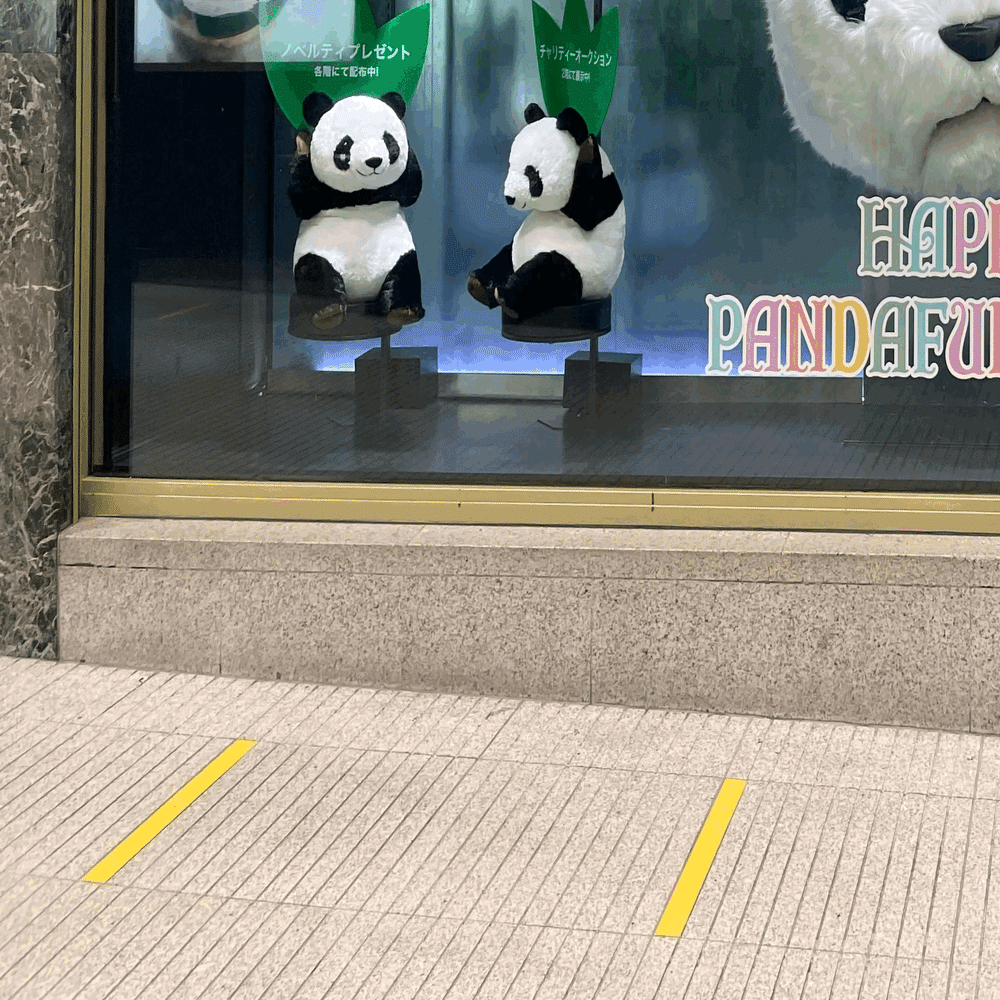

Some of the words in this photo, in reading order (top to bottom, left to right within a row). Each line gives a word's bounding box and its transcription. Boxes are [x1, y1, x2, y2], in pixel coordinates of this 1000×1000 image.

[540, 44, 612, 67] チャリティーオークション
